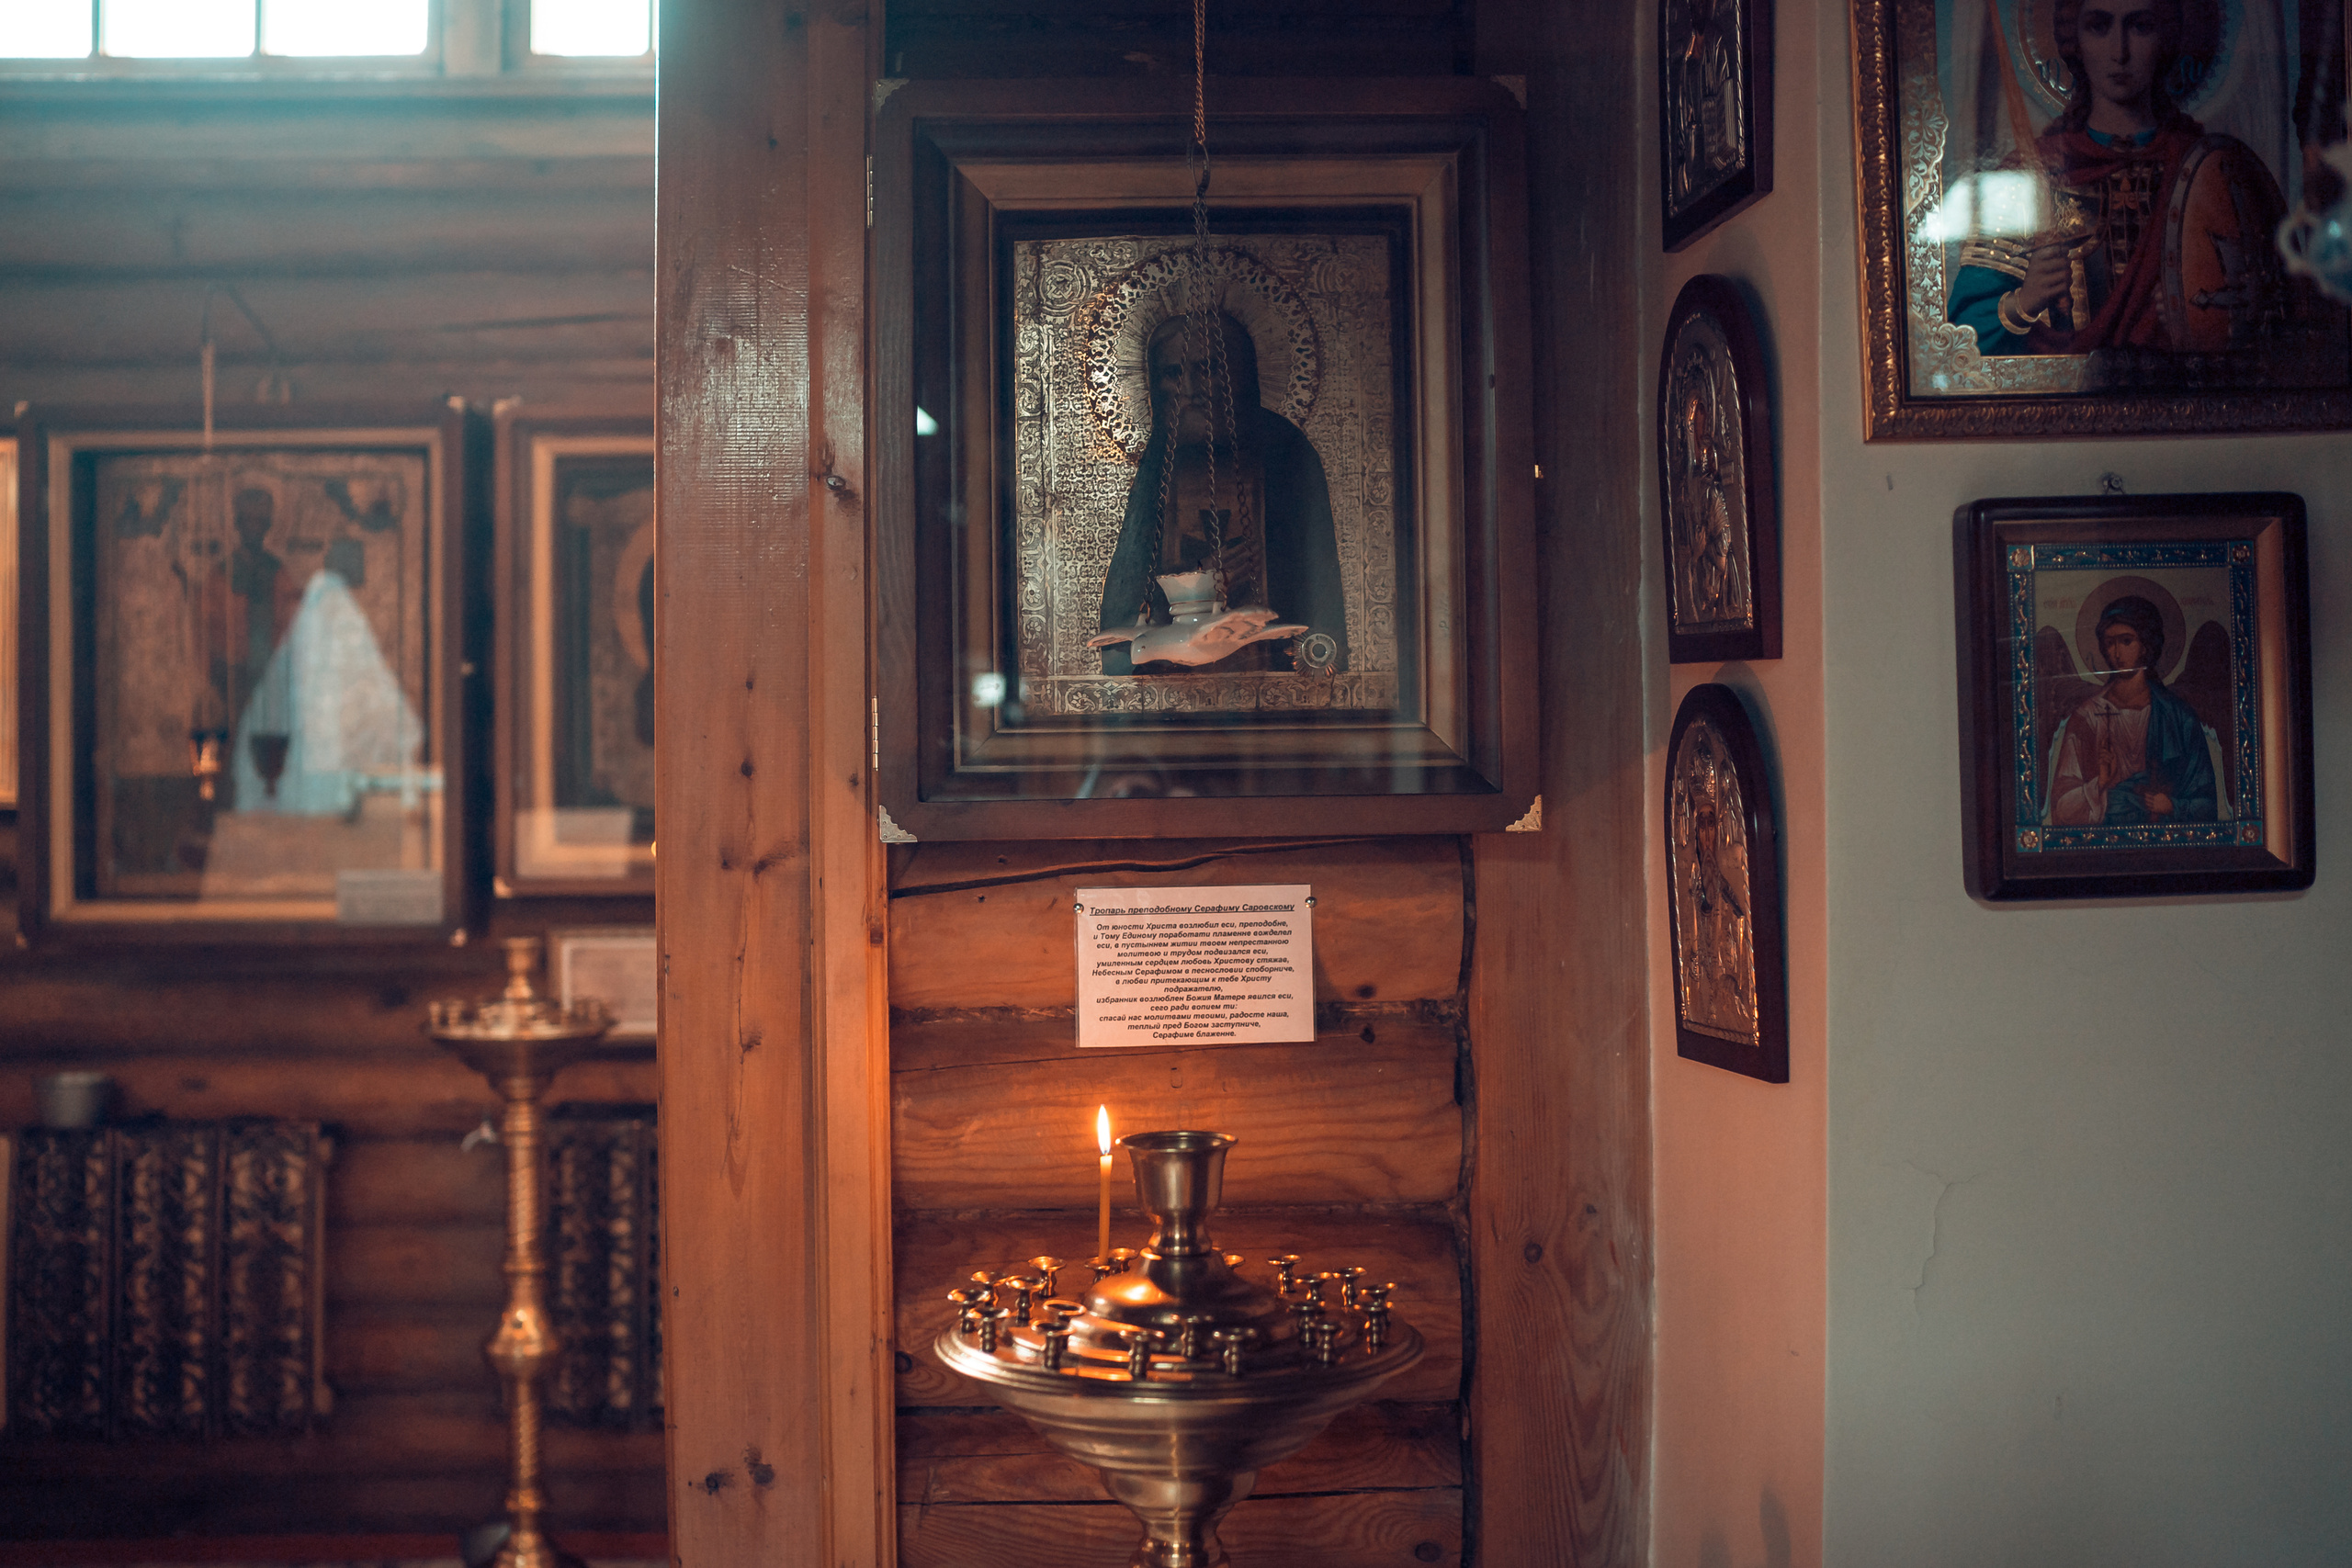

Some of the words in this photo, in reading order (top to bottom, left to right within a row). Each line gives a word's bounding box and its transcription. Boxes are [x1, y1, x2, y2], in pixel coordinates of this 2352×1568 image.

[1090, 908, 1126, 916] Тропарь
[1127, 906, 1193, 915] преподобному
[1194, 904, 1240, 914] Серафиму
[1242, 904, 1295, 912] Саровскому
[1146, 922, 1177, 931] Христа
[1101, 932, 1121, 941] Тому
[1122, 931, 1158, 941] Единому
[1159, 931, 1211, 940] поработати
[1121, 942, 1169, 950] пустыннем
[1228, 939, 1289, 947] непрестанною
[1170, 949, 1203, 957] трудом
[1097, 960, 1143, 968] умиленным
[1145, 958, 1180, 967] сердцем
[1214, 956, 1255, 965] Христову
[1135, 967, 1183, 976] Серафимом
[1240, 975, 1272, 983] Христу
[1096, 996, 1137, 1005] избранник
[1214, 993, 1246, 1002] Матере
[1170, 1003, 1190, 1012] ради
[1229, 1010, 1265, 1020] радосте
[1162, 1021, 1182, 1031] пред
[1152, 1031, 1194, 1040] Серафиме
